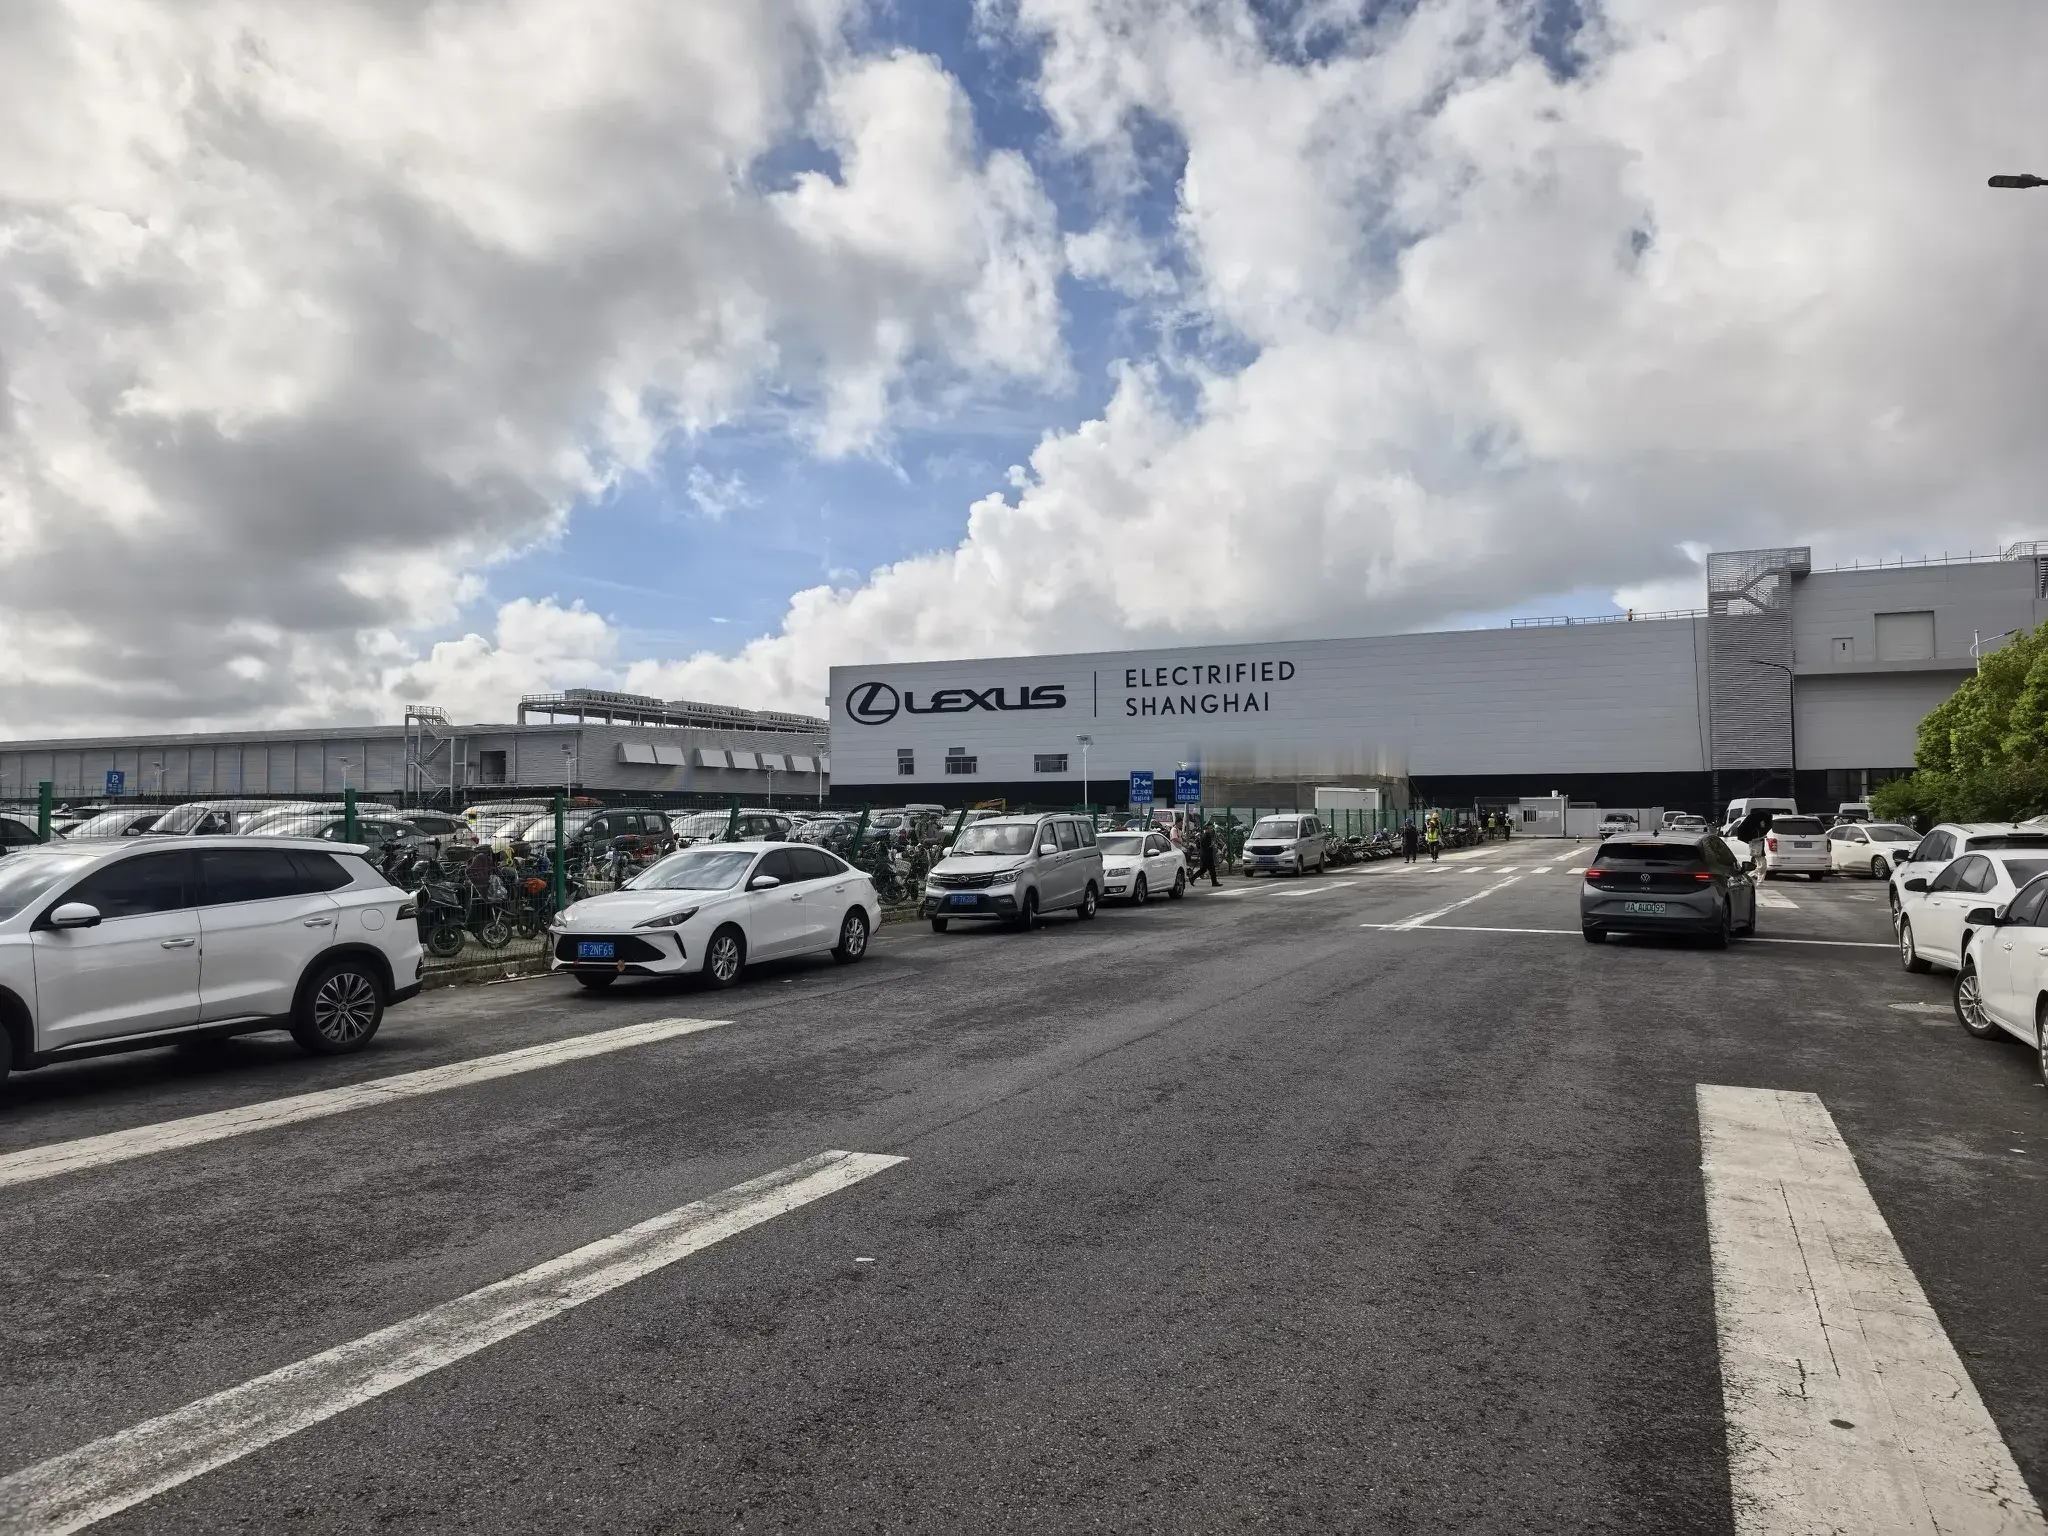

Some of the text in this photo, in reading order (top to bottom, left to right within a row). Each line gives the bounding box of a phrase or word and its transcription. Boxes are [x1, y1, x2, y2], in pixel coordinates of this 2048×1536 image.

[1125, 660, 1296, 688] ELECTRIFIED
[904, 684, 1067, 714] LEXUS
[1126, 691, 1270, 717] SHANGHAI
